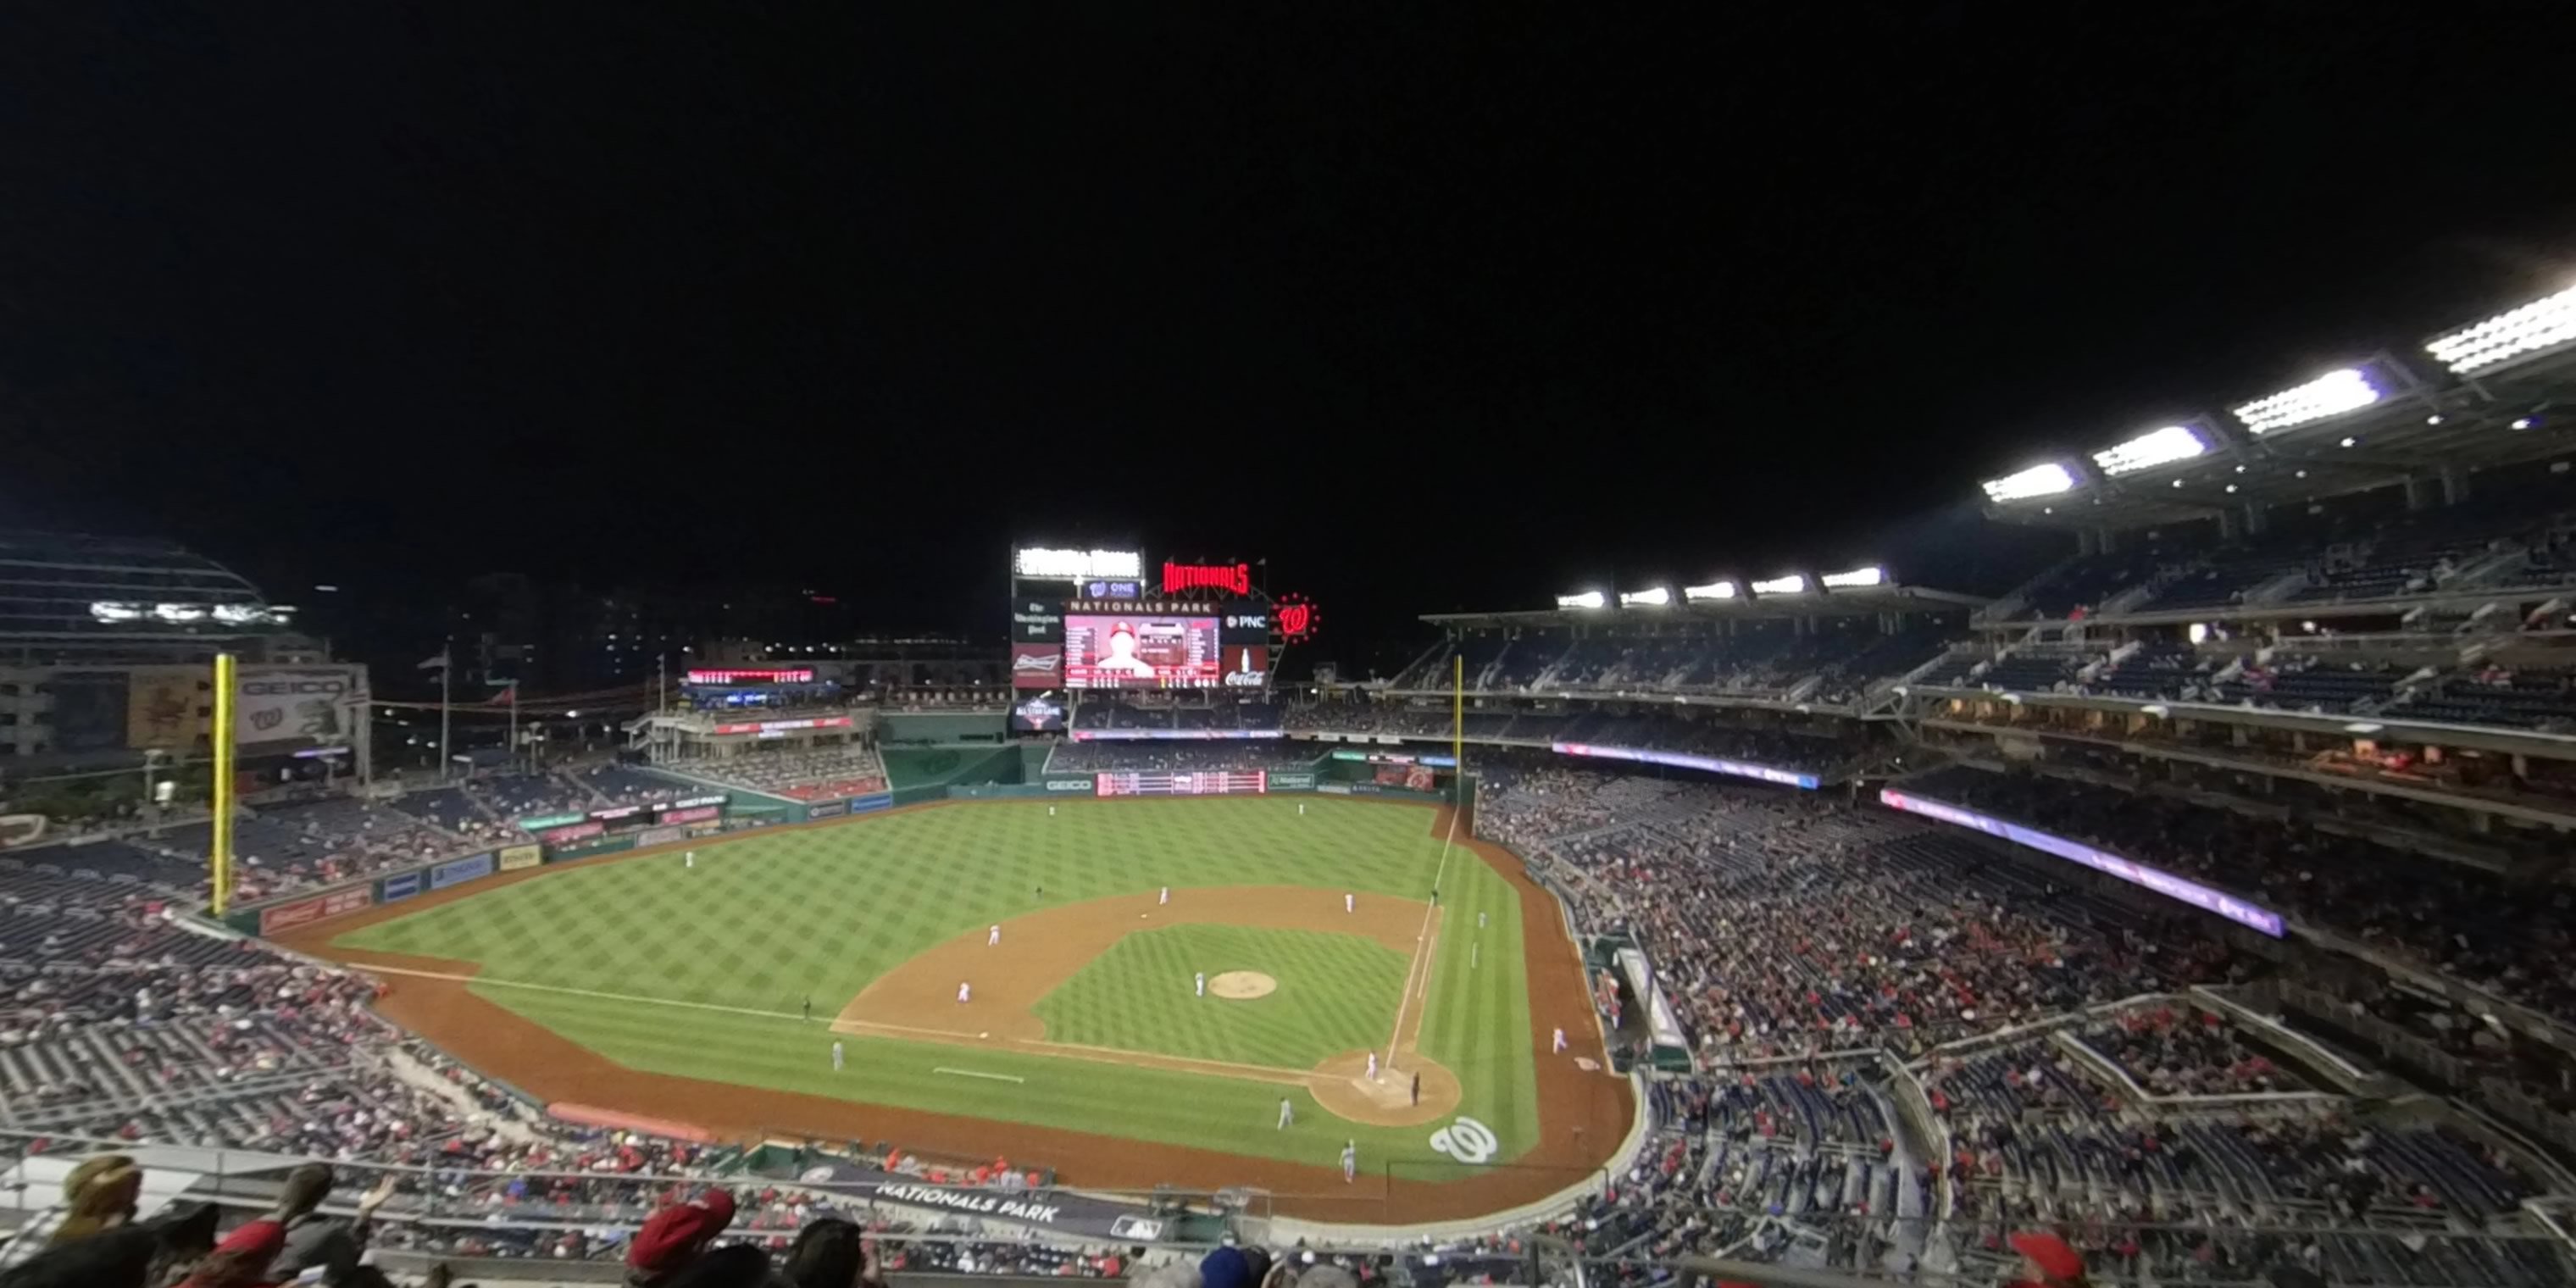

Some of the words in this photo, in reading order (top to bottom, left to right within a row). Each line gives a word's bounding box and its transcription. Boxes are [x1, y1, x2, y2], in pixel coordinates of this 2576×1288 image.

[1164, 563, 1249, 594] NATIONALS
[1111, 583, 1135, 593] ONE
[1070, 602, 1163, 612] NATIONALS
[1171, 602, 1211, 612] PARK
[1239, 615, 1266, 628] PNC
[242, 681, 344, 696] GEICO
[1046, 780, 1091, 791] GEICO
[876, 1182, 995, 1213] NATIONALS
[998, 1200, 1059, 1224] PARK
